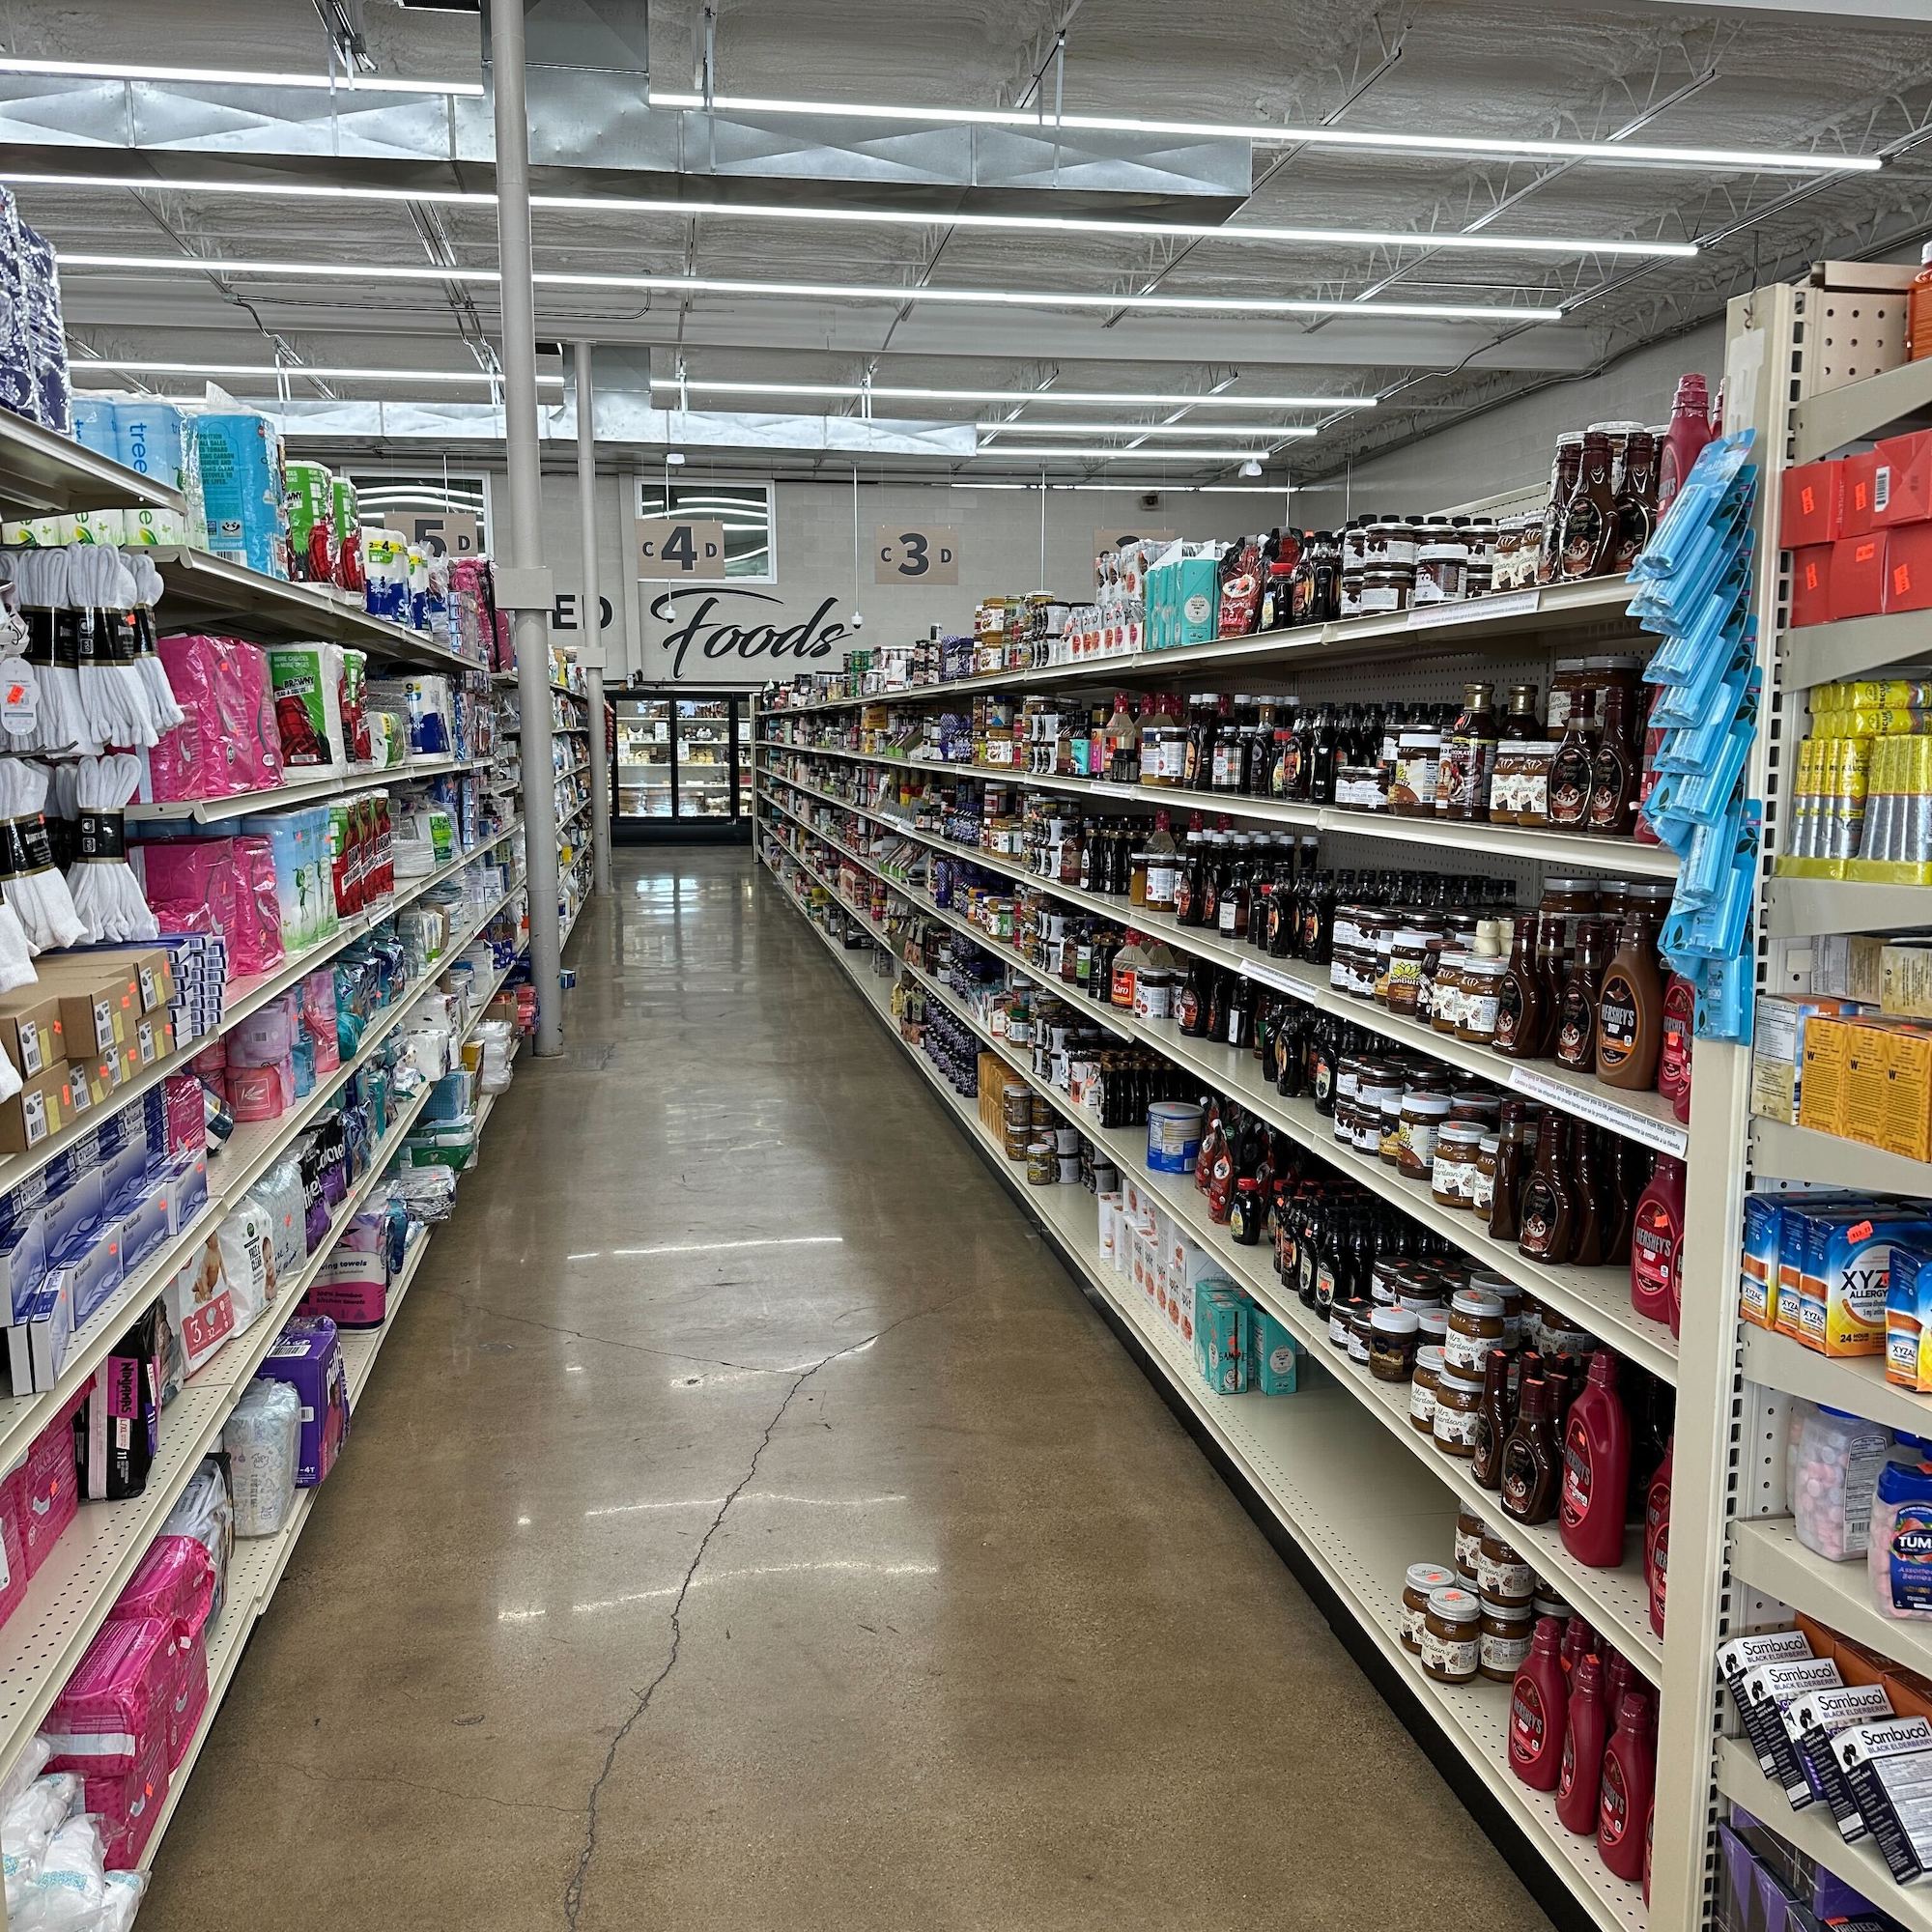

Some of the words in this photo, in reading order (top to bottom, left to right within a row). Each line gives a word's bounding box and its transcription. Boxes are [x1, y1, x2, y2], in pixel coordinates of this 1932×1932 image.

[287, 491, 302, 501] WNY
[414, 520, 447, 557] 5
[458, 535, 470, 551] D
[642, 542, 654, 557] C
[661, 526, 697, 571] 4
[705, 542, 718, 558] D
[881, 547, 892, 562] C
[897, 532, 929, 576] 3
[941, 548, 952, 563] D
[650, 587, 853, 680] Foods
[284, 675, 315, 689] BRAWNY
[1113, 983, 1129, 995] Karo
[1602, 1004, 1634, 1028] HERSHEY'S
[1636, 1226, 1671, 1258] HERSHEY'S
[340, 1260, 368, 1268] towels
[1841, 1270, 1889, 1291] XYZ
[1850, 1289, 1889, 1299] ALLERGY
[1781, 1298, 1799, 1312] XYZA
[190, 1320, 202, 1343] 3
[1840, 1334, 1852, 1343] 24
[118, 1362, 134, 1414] NINJAMAS
[1898, 1536, 1932, 1549] TUM
[1898, 1566, 1932, 1575] Assorte
[1747, 1655, 1767, 1663] BLACK
[1769, 1650, 1808, 1661] ELDERBERRY
[1774, 1682, 1795, 1690] BLACK
[1796, 1678, 1837, 1689] ELDERBERRY
[1514, 1695, 1542, 1735] HERSHEY'S
[1823, 1710, 1845, 1719] BLACK
[1846, 1705, 1889, 1717] ELDERBERRY
[1867, 1746, 1889, 1754] BLACK
